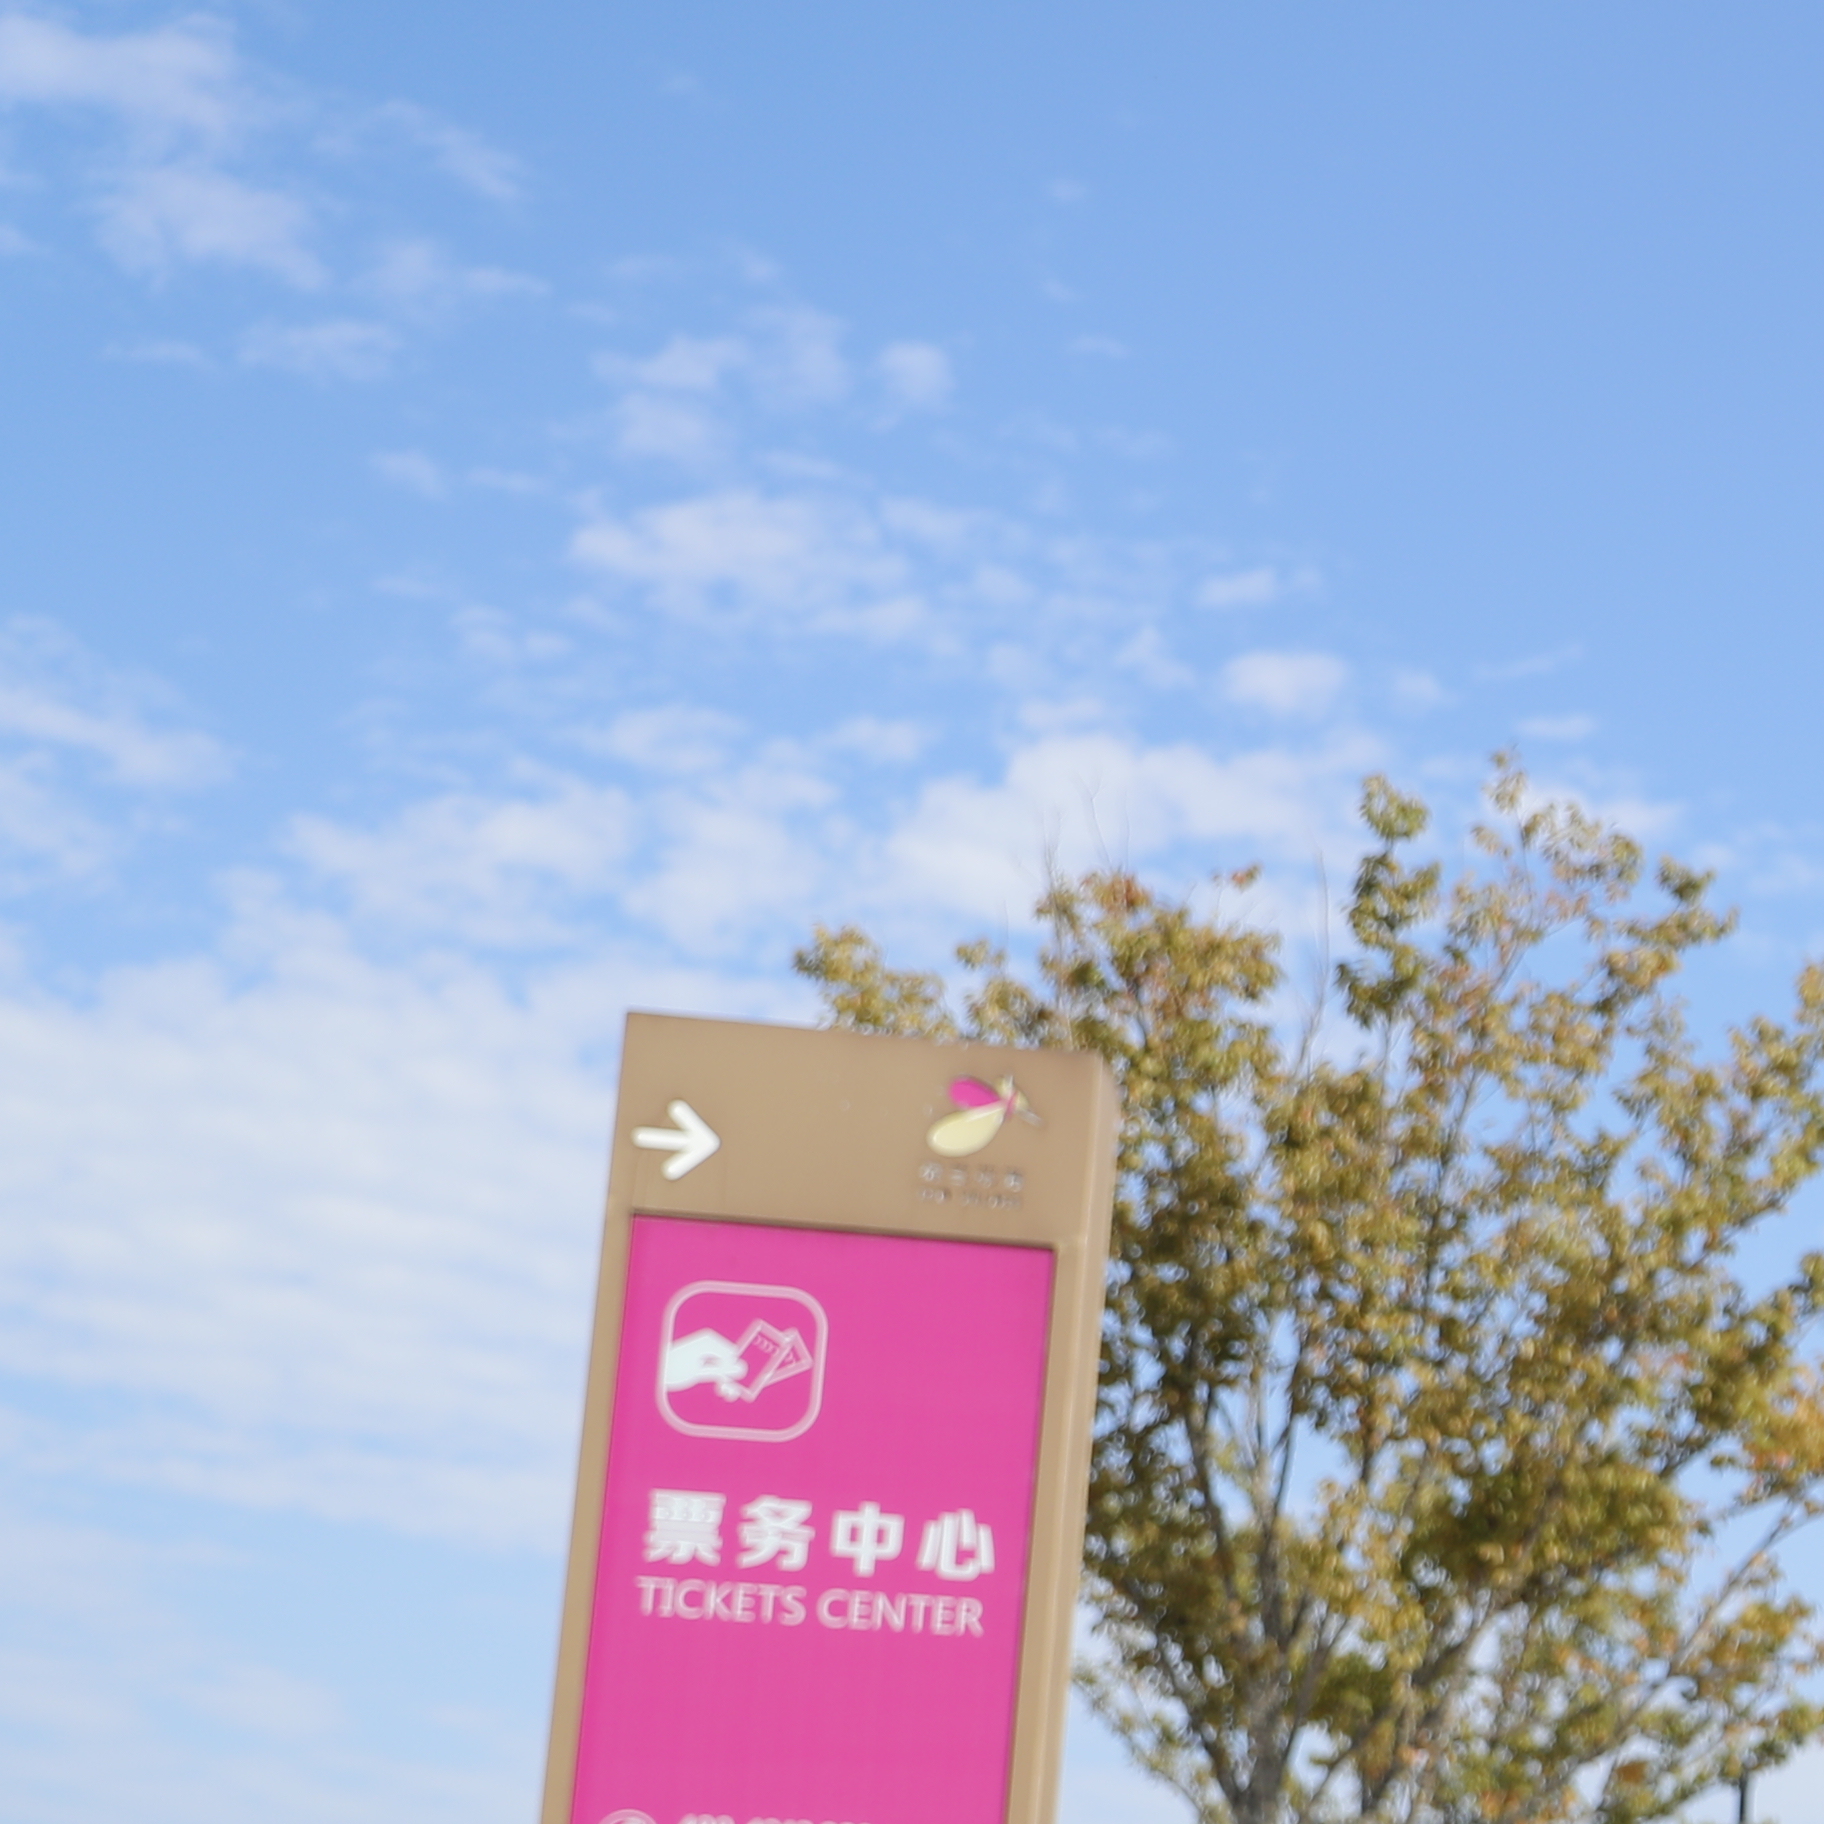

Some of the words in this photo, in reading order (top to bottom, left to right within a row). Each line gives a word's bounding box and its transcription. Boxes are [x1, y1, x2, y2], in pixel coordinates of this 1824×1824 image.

[643, 1488, 995, 1582] 票务中心
[634, 1575, 807, 1626] TICKETS
[816, 1588, 985, 1638] CENTER
